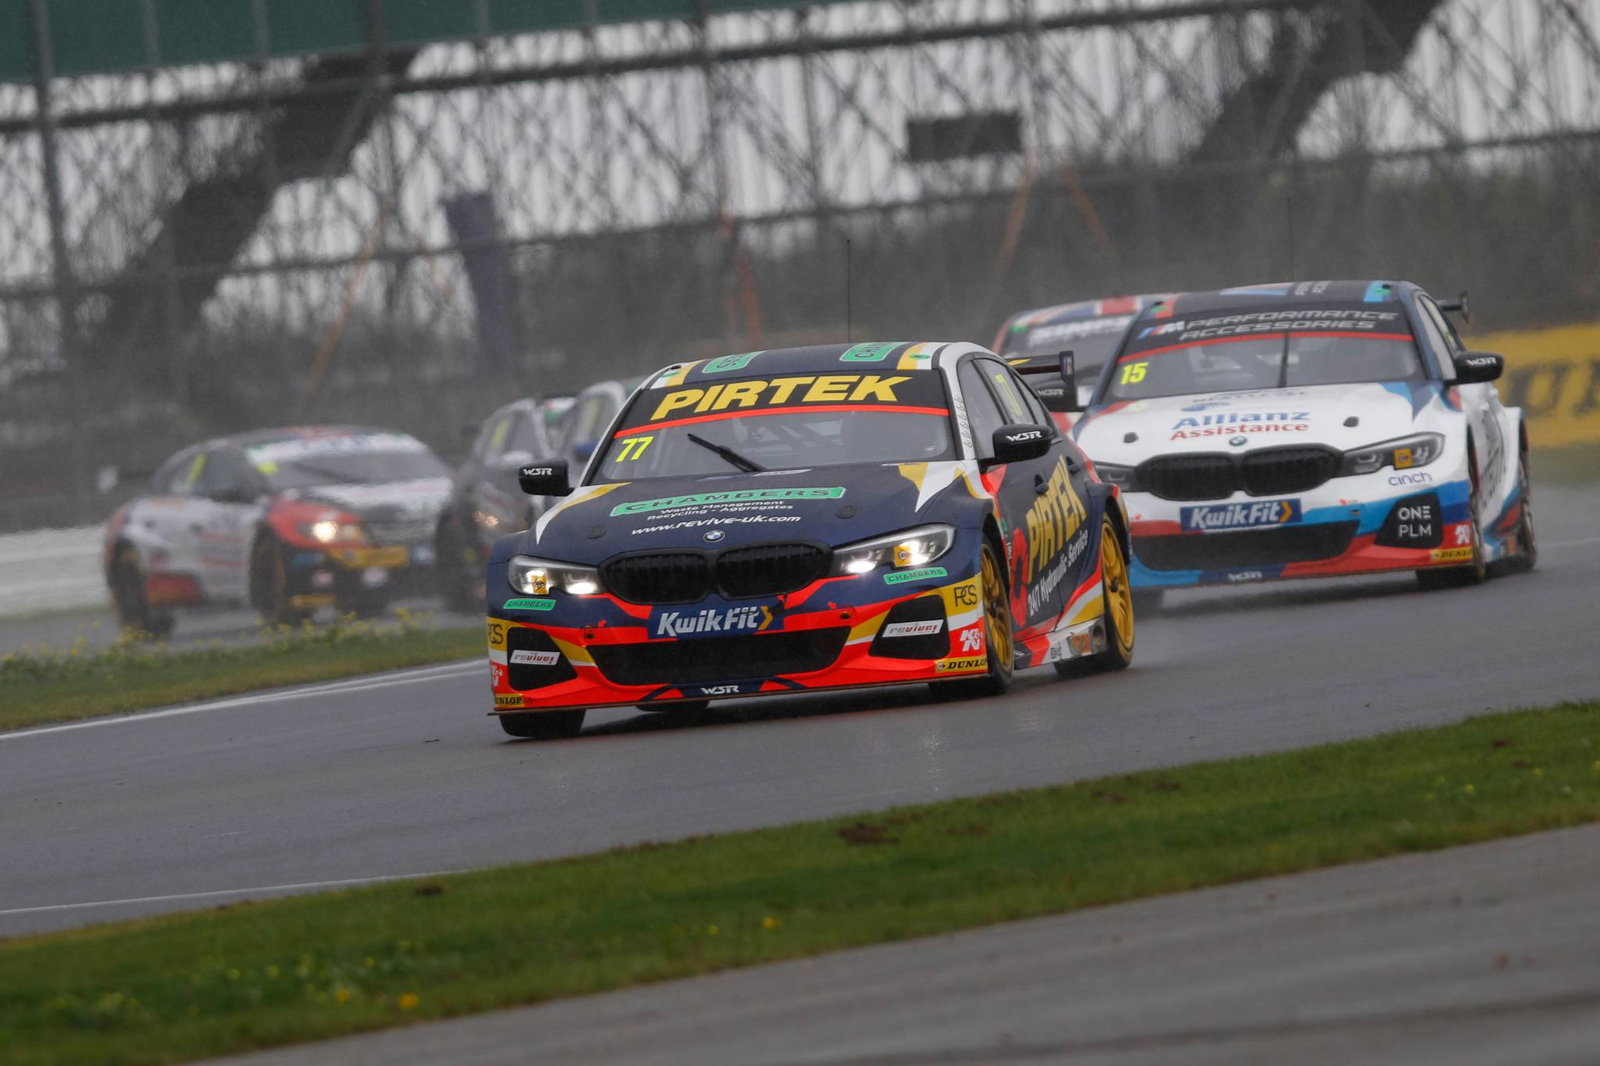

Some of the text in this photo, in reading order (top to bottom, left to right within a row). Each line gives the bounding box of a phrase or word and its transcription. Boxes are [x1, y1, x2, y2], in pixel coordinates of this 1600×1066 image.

[1186, 310, 1399, 330] PERFORMANCE
[1180, 321, 1376, 340] ACCESSORIES
[1466, 357, 1497, 366] WSR
[1120, 362, 1149, 385] 15
[650, 375, 912, 420] PIRTEK
[1171, 412, 1311, 430] Allianz
[1006, 431, 1042, 442] WSR
[1169, 423, 1310, 441] Assistance
[615, 436, 654, 463] 77
[523, 467, 553, 476] WSR
[1388, 472, 1432, 487] cinch
[625, 489, 831, 511] CHAMBERS
[660, 500, 784, 514] Waste Management
[647, 509, 708, 521] Recycling
[1026, 455, 1087, 584] PIRTEK
[1398, 505, 1431, 520] ONE
[632, 515, 801, 535] www.revive-uk.com
[1399, 524, 1432, 538] PLM
[888, 568, 944, 582] CHAMBERS
[701, 685, 740, 694] WSR
